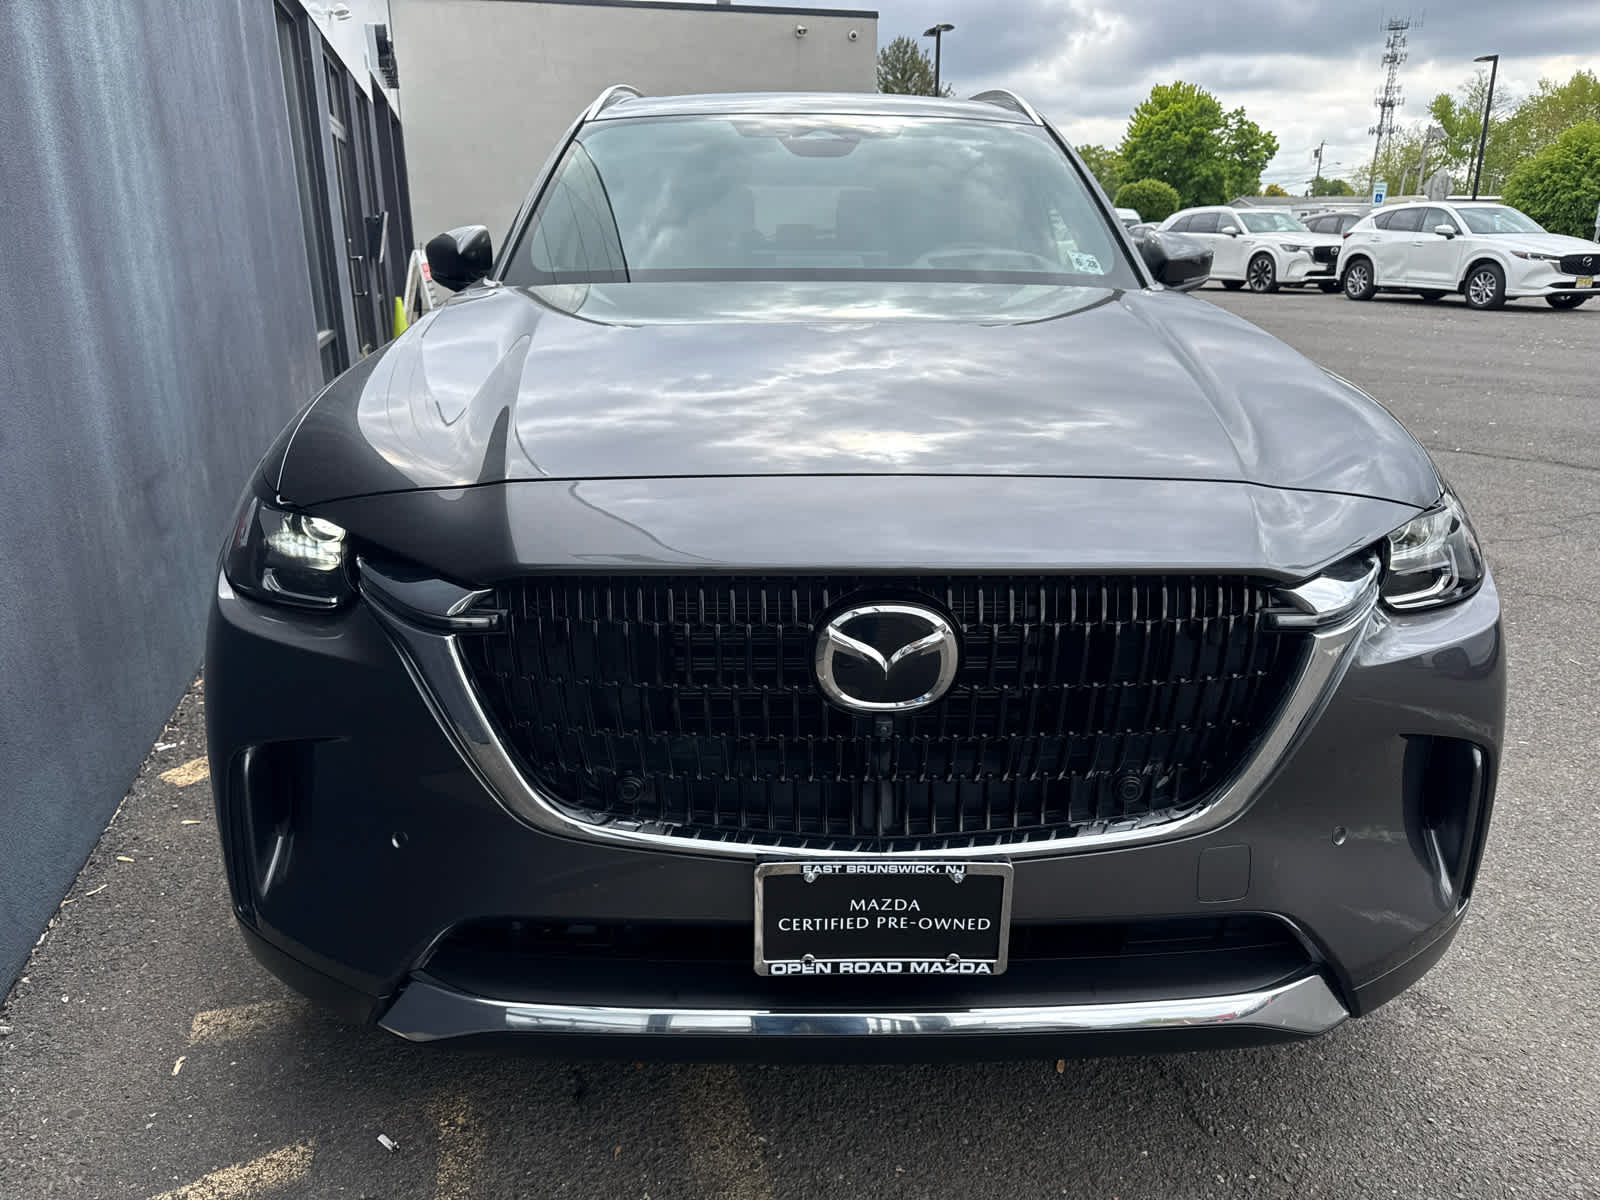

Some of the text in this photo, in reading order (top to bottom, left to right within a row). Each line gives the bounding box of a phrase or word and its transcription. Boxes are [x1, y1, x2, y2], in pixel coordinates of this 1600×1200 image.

[803, 865, 965, 873] EAST BRUNSWICK, NJ
[850, 898, 920, 912] MAZDA
[778, 916, 991, 931] CERTIFIED PRE-OWNED
[770, 962, 991, 975] OPEN ROAD MAZDA
